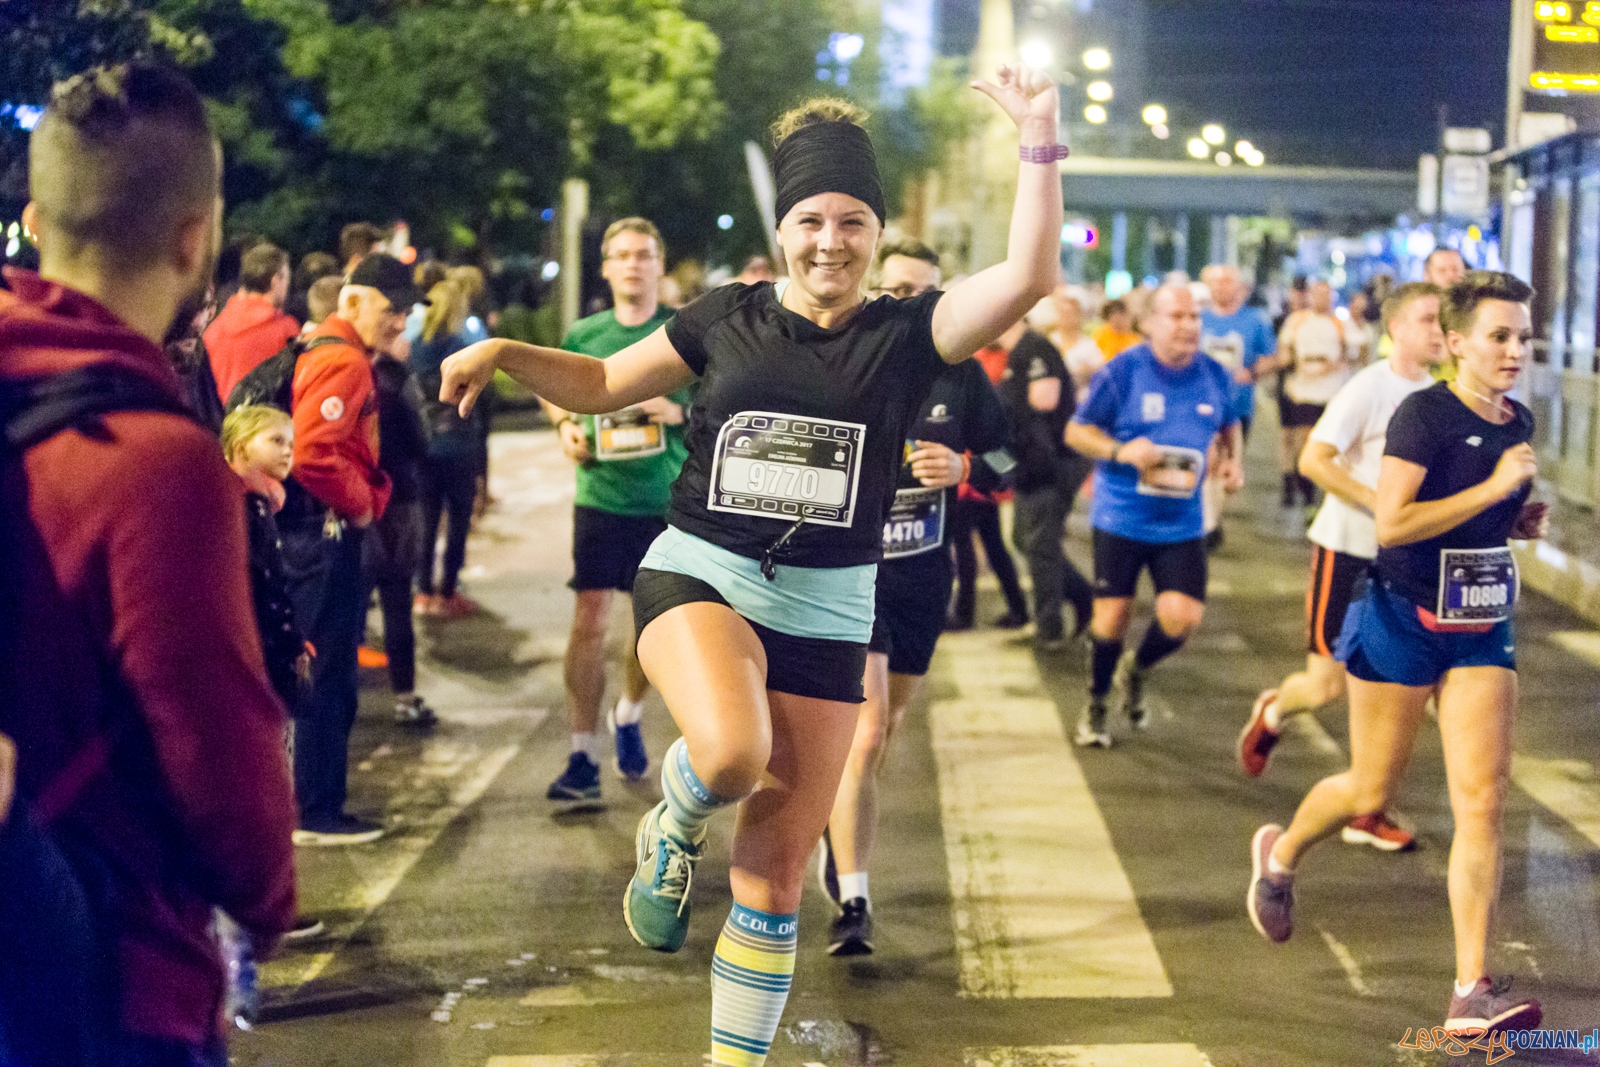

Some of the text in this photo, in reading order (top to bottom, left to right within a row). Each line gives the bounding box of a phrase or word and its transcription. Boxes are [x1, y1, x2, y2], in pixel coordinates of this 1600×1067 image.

[798, 441, 813, 449] 2017
[747, 462, 819, 499] 9770
[737, 912, 797, 935] COLOR
